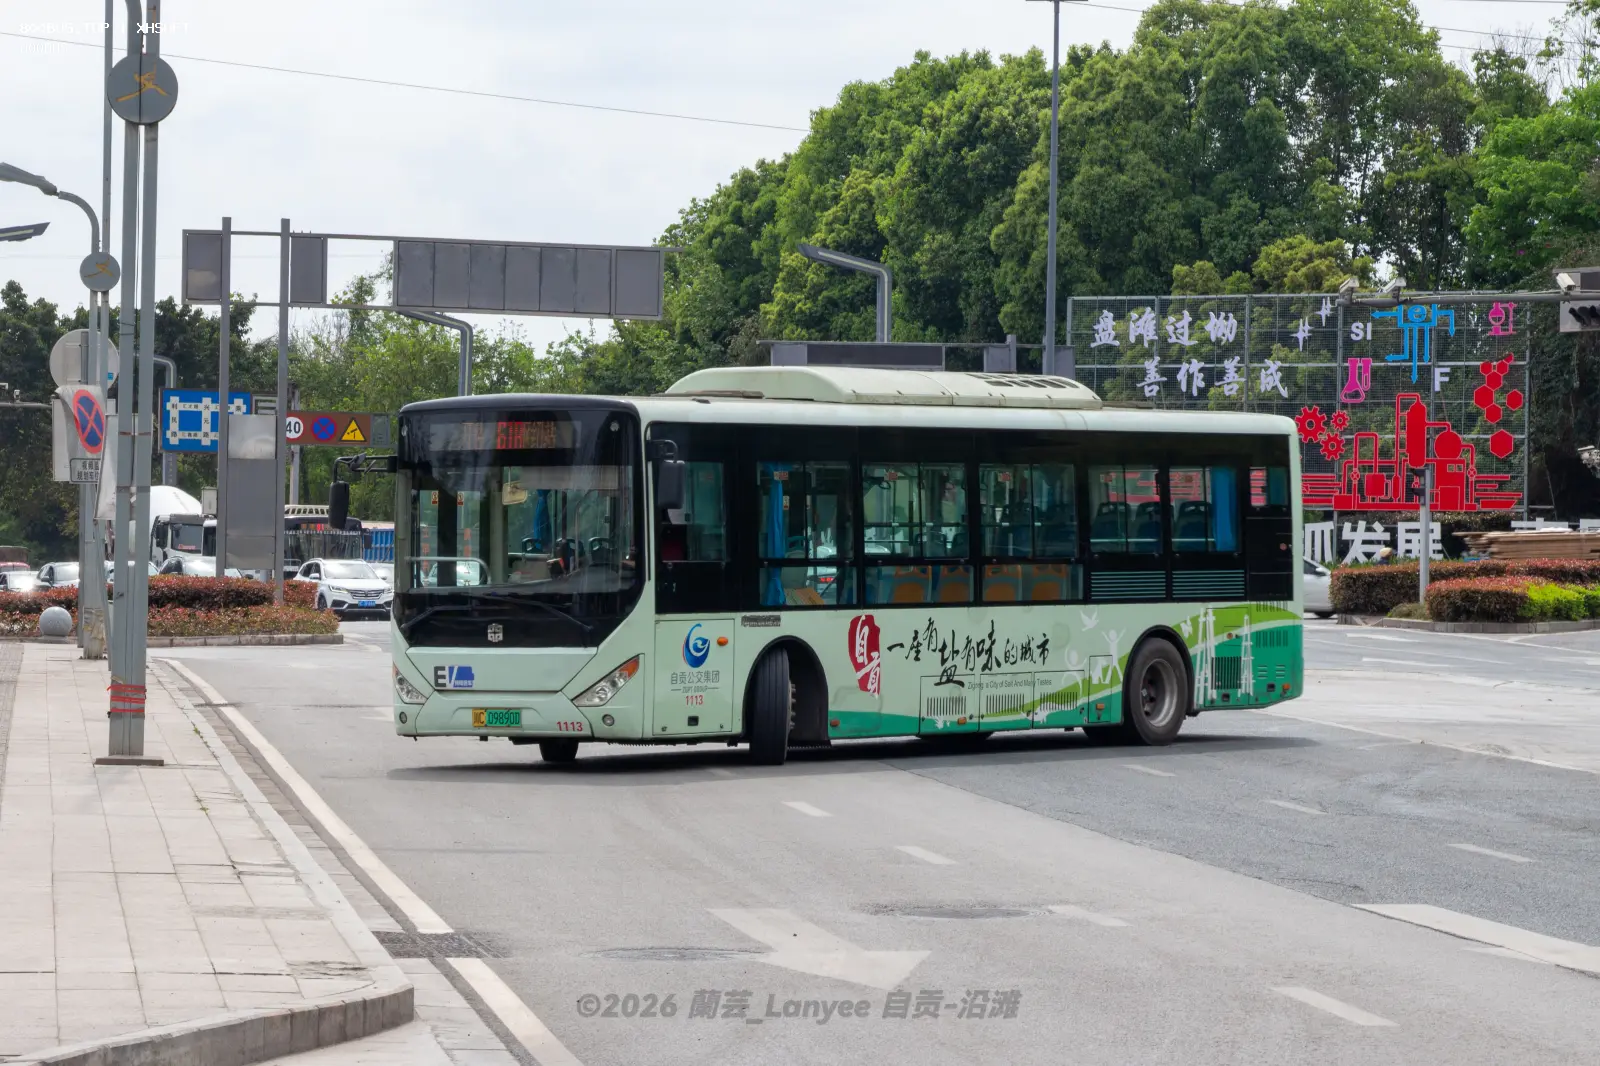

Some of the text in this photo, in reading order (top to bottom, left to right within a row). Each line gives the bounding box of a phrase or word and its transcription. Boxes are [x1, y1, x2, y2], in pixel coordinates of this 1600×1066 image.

[1136, 356, 1288, 398] 善作善成
[1434, 367, 1450, 392] F
[286, 421, 301, 434] 40
[887, 617, 1050, 688] 一座有盐有味的城市
[670, 670, 720, 685] 自贡公交集团
[685, 695, 704, 705] 1113
[556, 721, 583, 732] 1113
